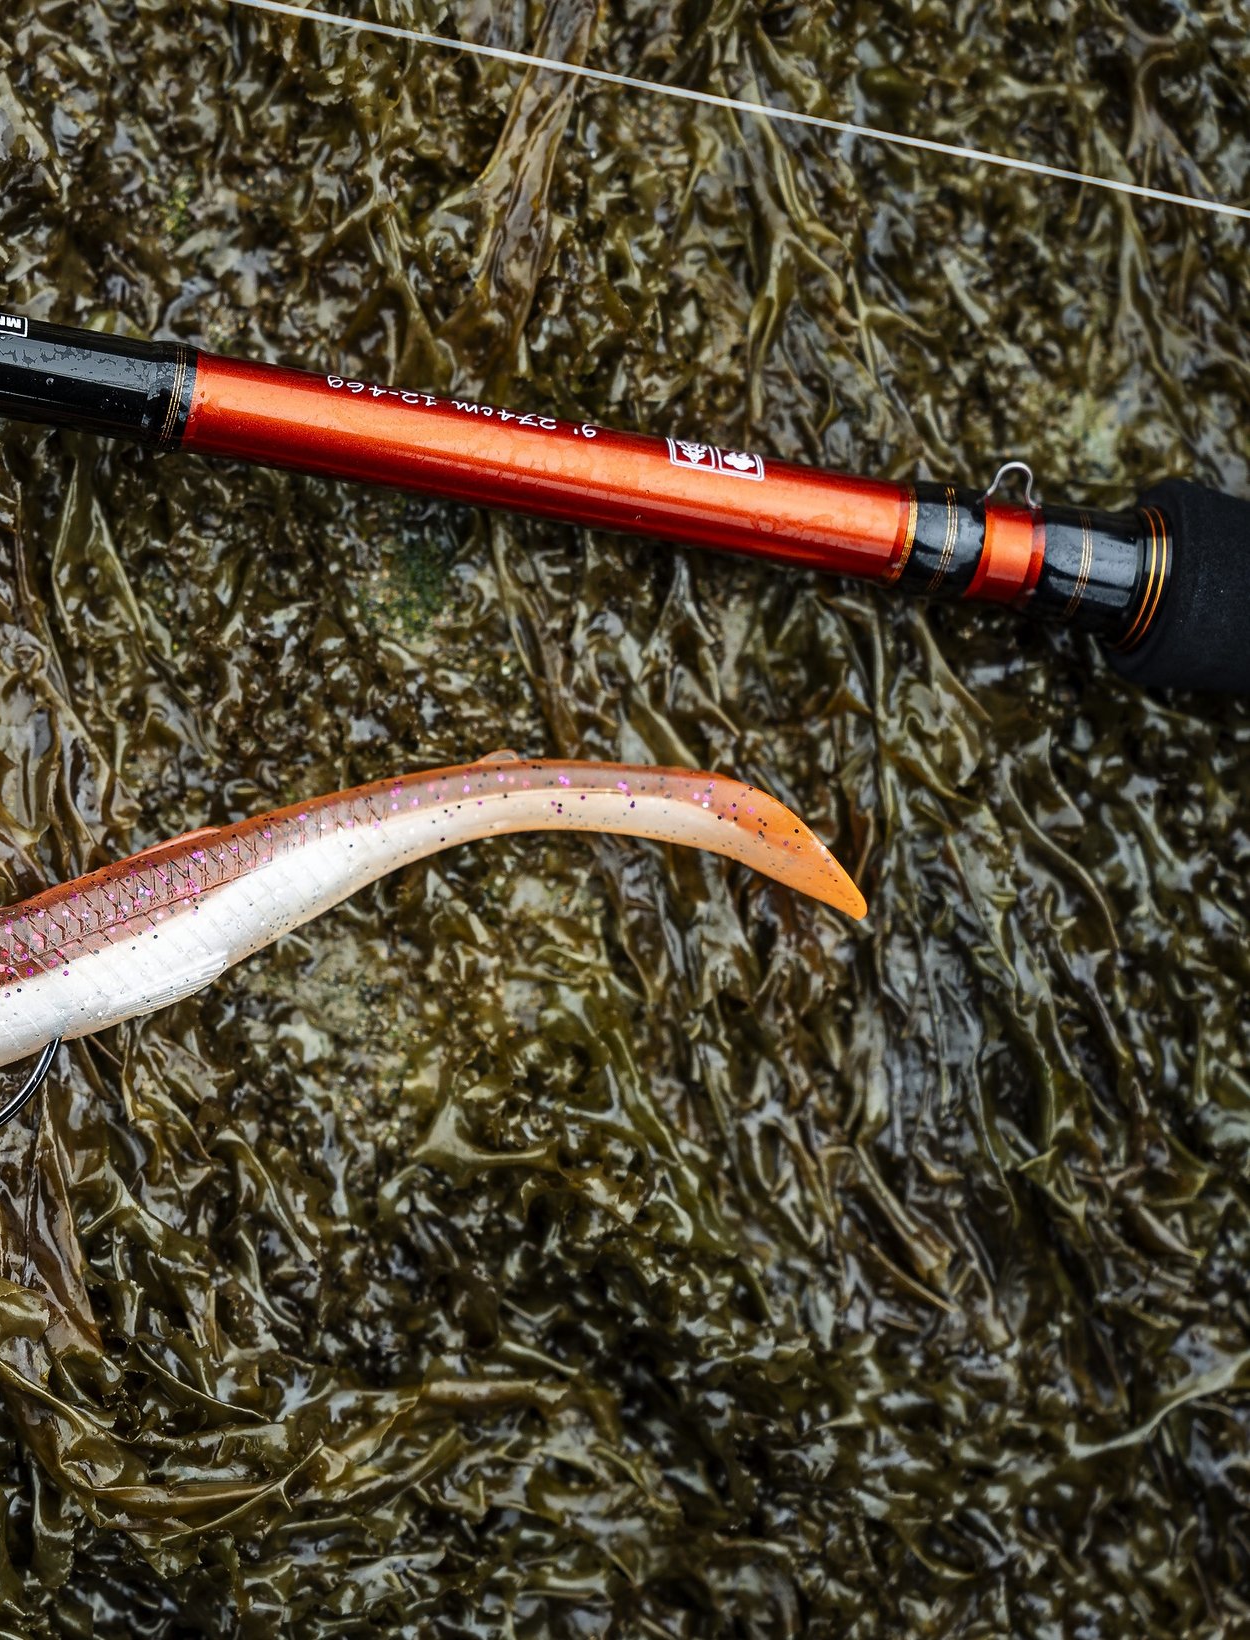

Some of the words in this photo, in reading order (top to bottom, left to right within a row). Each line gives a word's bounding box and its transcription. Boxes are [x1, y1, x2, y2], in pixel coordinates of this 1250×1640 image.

[327, 374, 437, 406] 12-46g
[451, 400, 557, 430] 274cm
[573, 423, 597, 438] 9'
